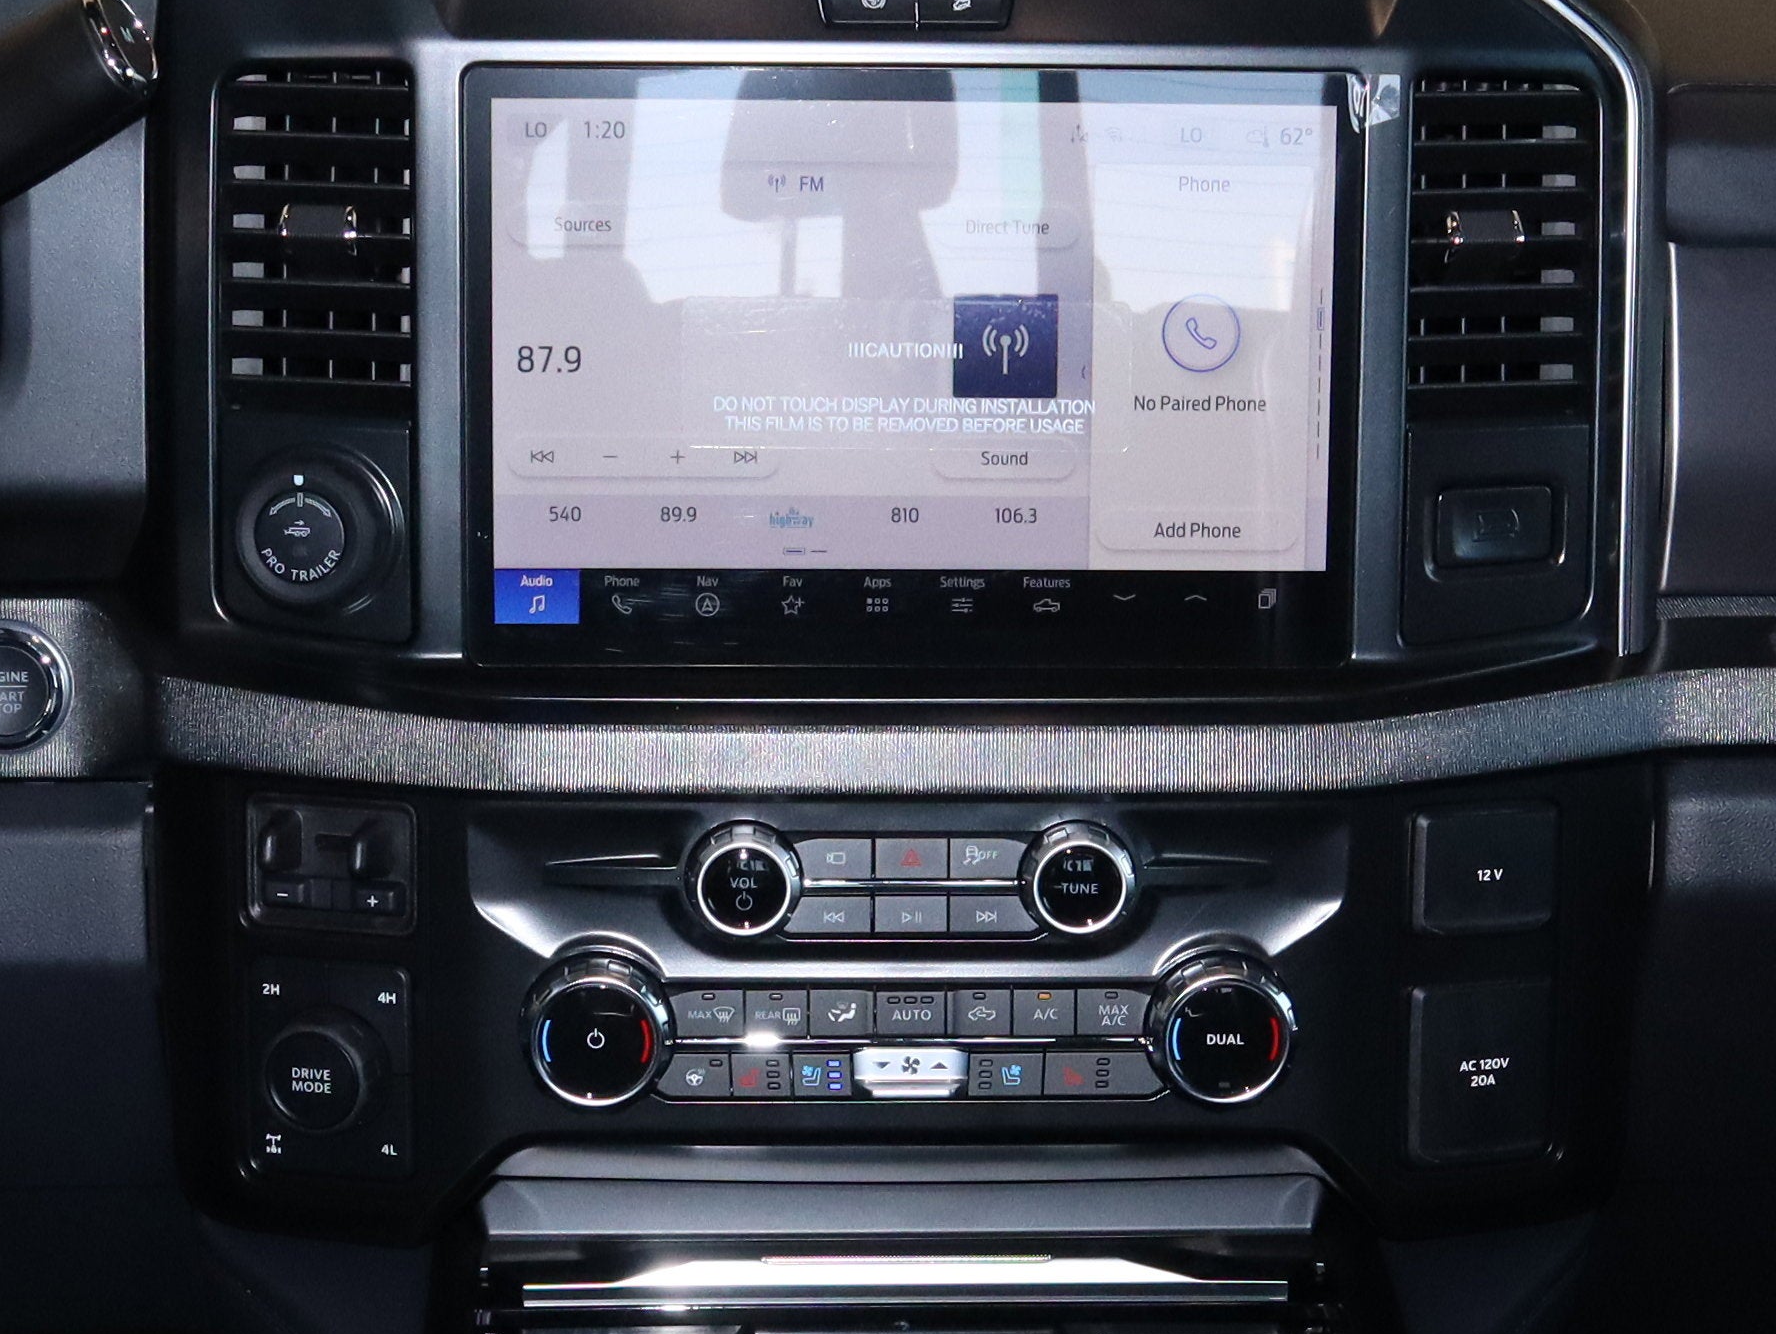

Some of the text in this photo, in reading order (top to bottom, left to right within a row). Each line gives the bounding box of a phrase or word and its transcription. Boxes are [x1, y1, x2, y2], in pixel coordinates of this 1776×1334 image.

[525, 121, 625, 139] LO 1:20
[1180, 128, 1202, 144] LO
[799, 176, 824, 192] FM
[1178, 176, 1231, 193] Phone
[554, 217, 612, 232] Sources
[965, 220, 1050, 235] Direct Tune
[517, 346, 582, 373] 87.9
[713, 396, 1096, 416] DO NOT TOUCH DISPLAY DURING INSTALLATION
[1134, 395, 1267, 412] No Paired Phone
[725, 416, 1084, 435] THIS FILM IS TO BE REMOVED BEFORE USAGE
[981, 452, 1028, 466] Sound
[549, 507, 697, 522] 540 89.9
[891, 508, 1037, 524] 810 106.3
[1154, 523, 1241, 539] Add Phone
[261, 548, 341, 582] PRO TRAILER
[520, 575, 553, 587] Audio
[604, 575, 640, 587] Phone
[696, 576, 719, 588] Nav
[782, 576, 803, 588] Fav
[863, 576, 892, 591] Apps
[940, 576, 985, 590] Settings
[1023, 576, 1071, 589] Features
[979, 850, 998, 860] OFF
[1477, 869, 1504, 881] 12 V
[730, 877, 758, 889] VOL
[1061, 883, 1099, 894] TUNE
[262, 983, 280, 995] 2H
[378, 992, 397, 1005] 4H
[892, 1010, 931, 1021] AUTO
[1034, 1008, 1058, 1020] A/C
[1099, 1004, 1129, 1015] MAX
[1101, 1016, 1127, 1026] A/C
[1207, 1034, 1244, 1045] DUAL
[1459, 1058, 1510, 1072] AC 120V
[292, 1067, 331, 1081] DRIVE
[1470, 1074, 1496, 1087] 20A
[292, 1081, 332, 1094] MODE
[381, 1144, 398, 1156] 4L
